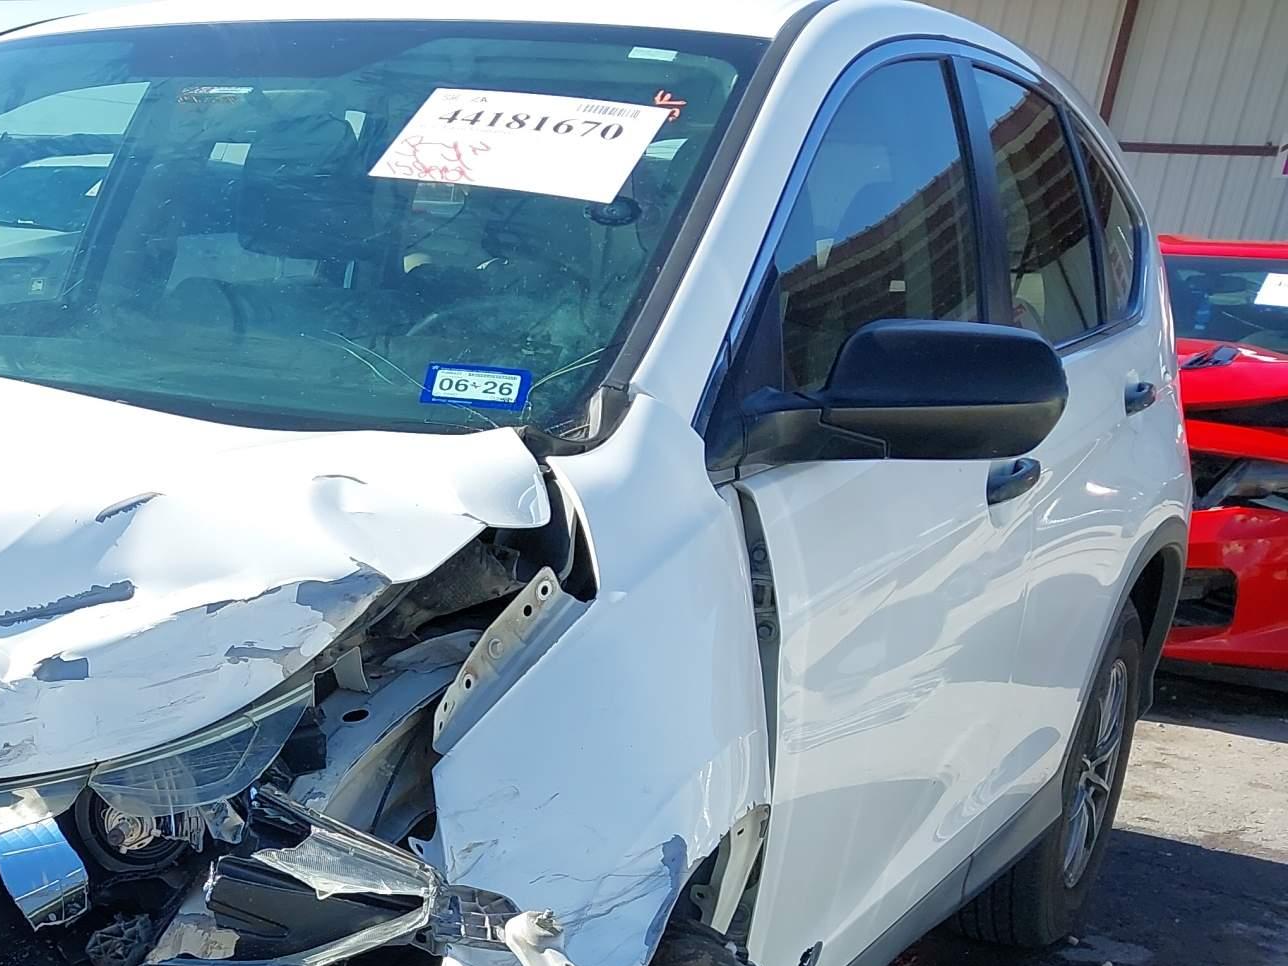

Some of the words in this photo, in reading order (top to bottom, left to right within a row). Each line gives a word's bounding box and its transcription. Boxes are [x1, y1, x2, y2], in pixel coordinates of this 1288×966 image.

[438, 109, 624, 141] 44181670
[438, 377, 470, 392] 06
[482, 380, 514, 396] 26
